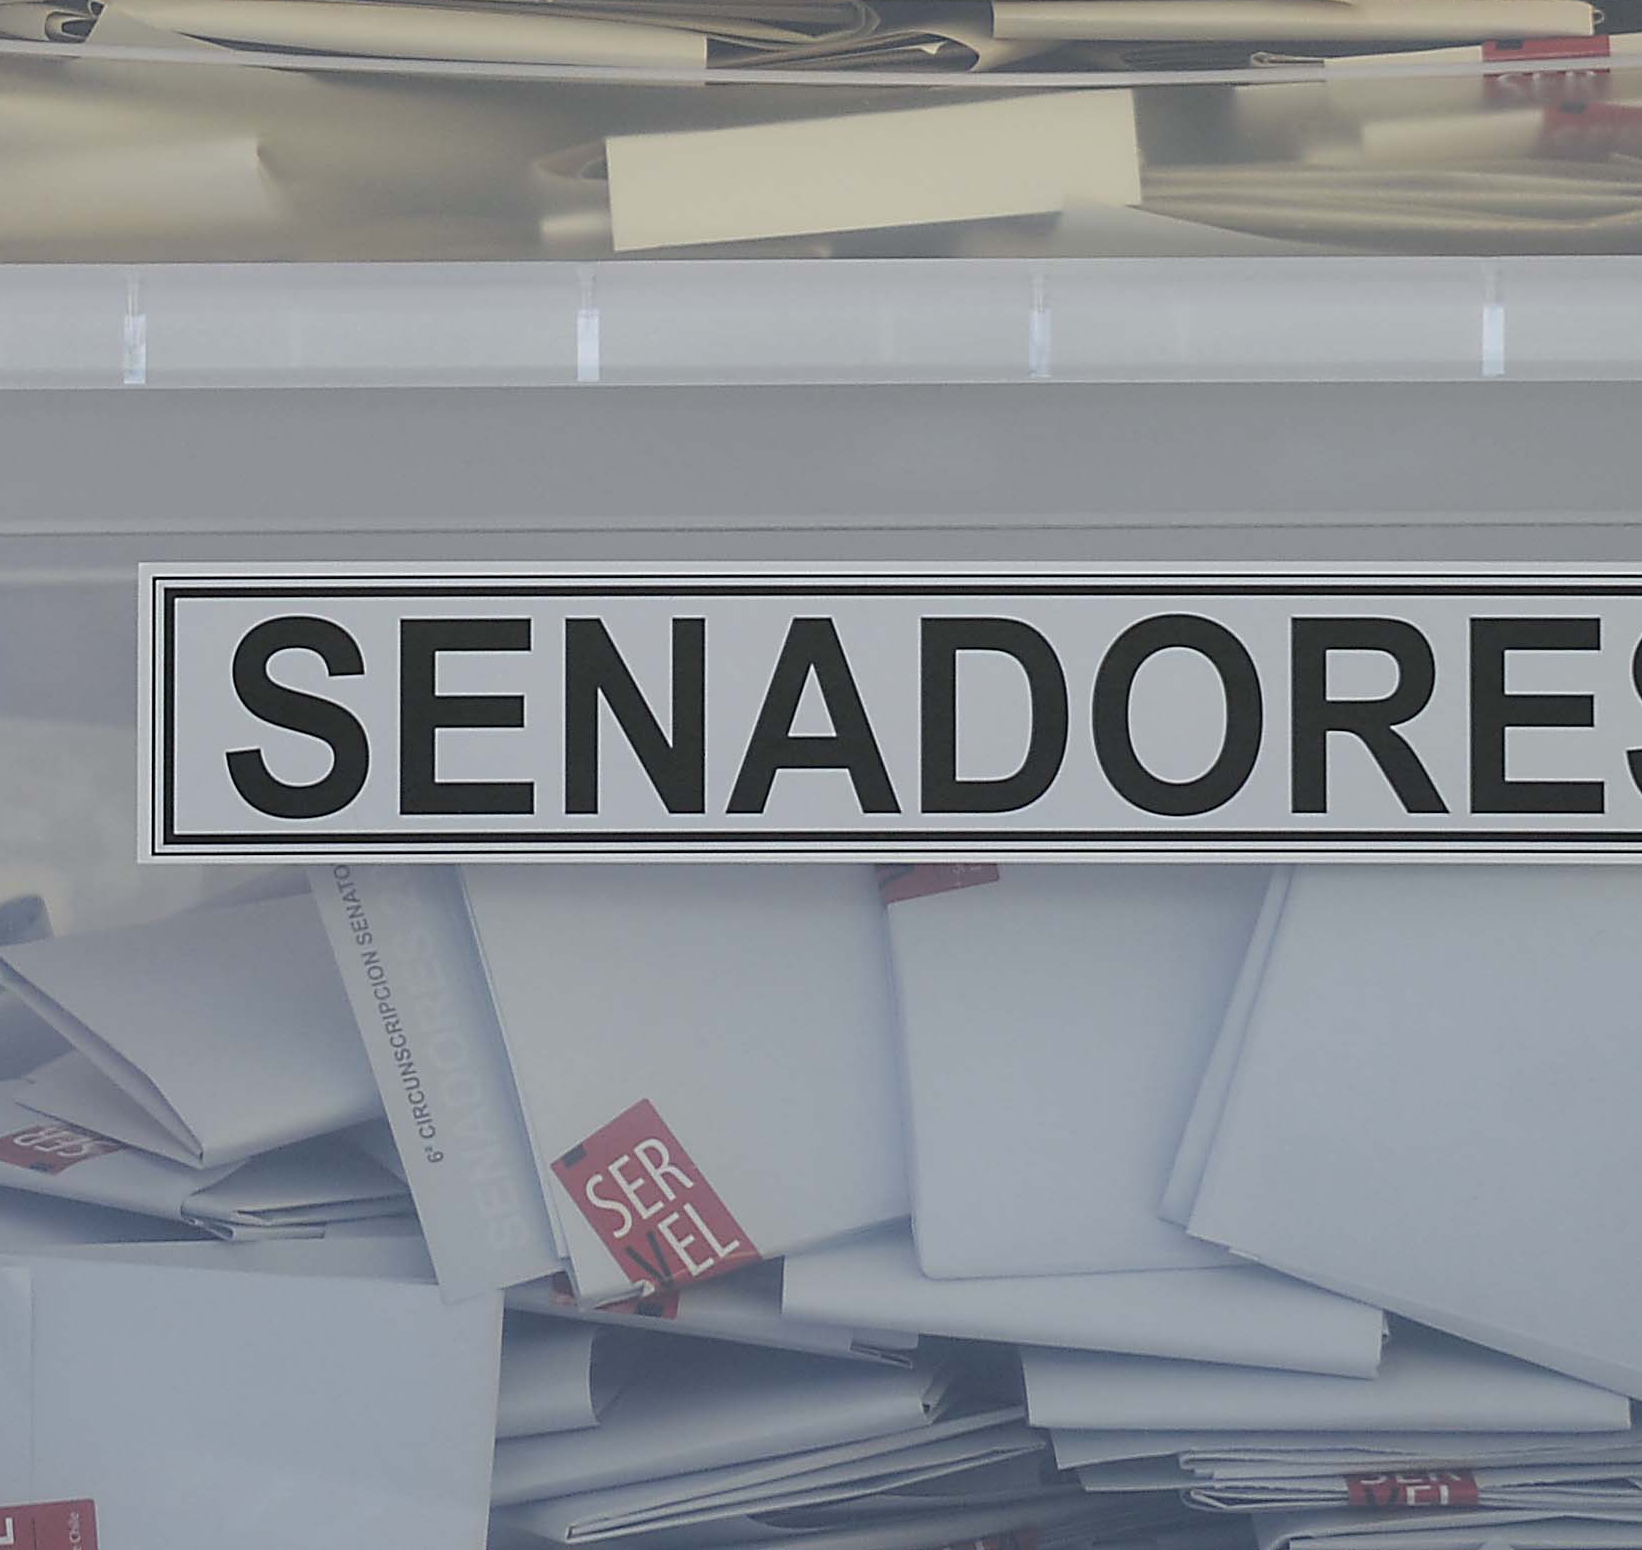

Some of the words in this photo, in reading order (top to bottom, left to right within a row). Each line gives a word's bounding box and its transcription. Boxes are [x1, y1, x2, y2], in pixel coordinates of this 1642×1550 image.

[333, 864, 373, 945] SENATO
[361, 950, 437, 1140] CIRCUNSCRIPCION
[585, 1136, 695, 1239] SER
[626, 1202, 739, 1288] VEL
